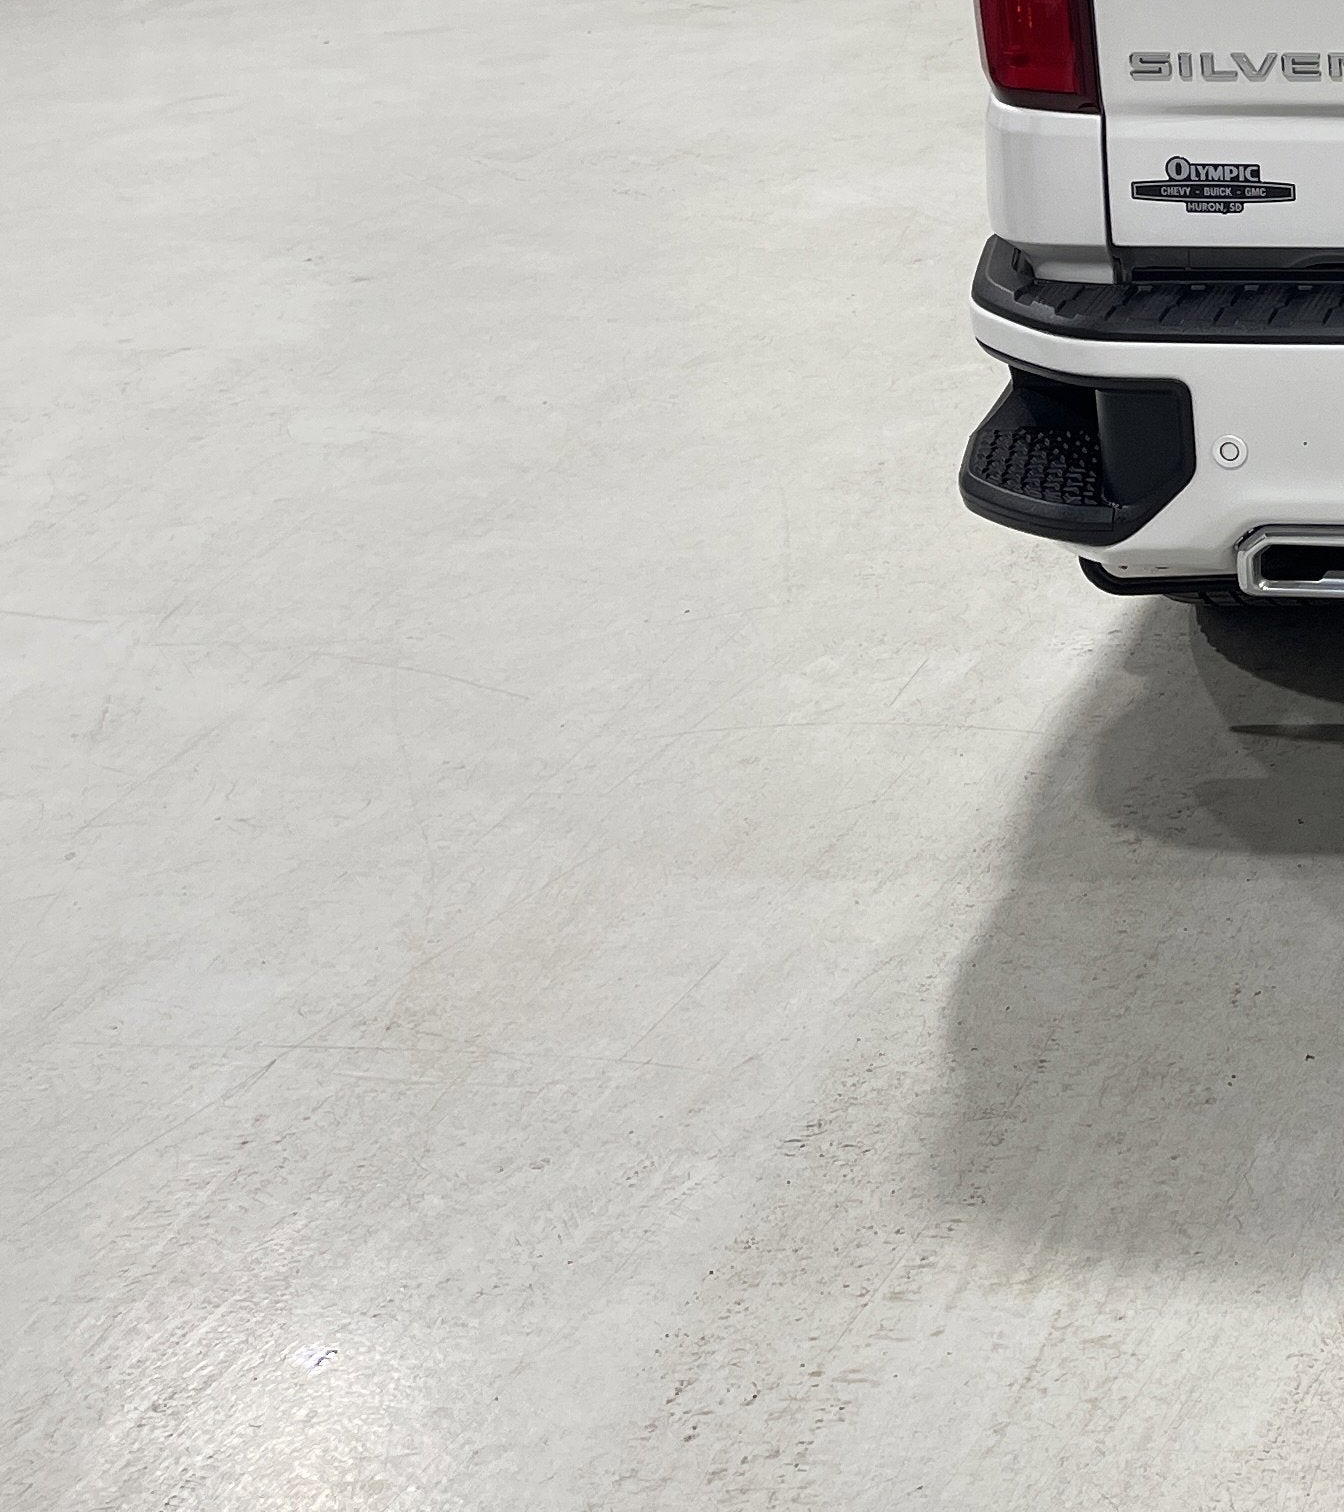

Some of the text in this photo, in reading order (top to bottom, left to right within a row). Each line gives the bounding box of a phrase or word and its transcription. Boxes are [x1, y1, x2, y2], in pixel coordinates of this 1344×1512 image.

[1167, 158, 1259, 181] OLYMPIC
[1160, 186, 1267, 197] CHEVY BUICK GMC
[1187, 202, 1243, 214] HURON, SD
